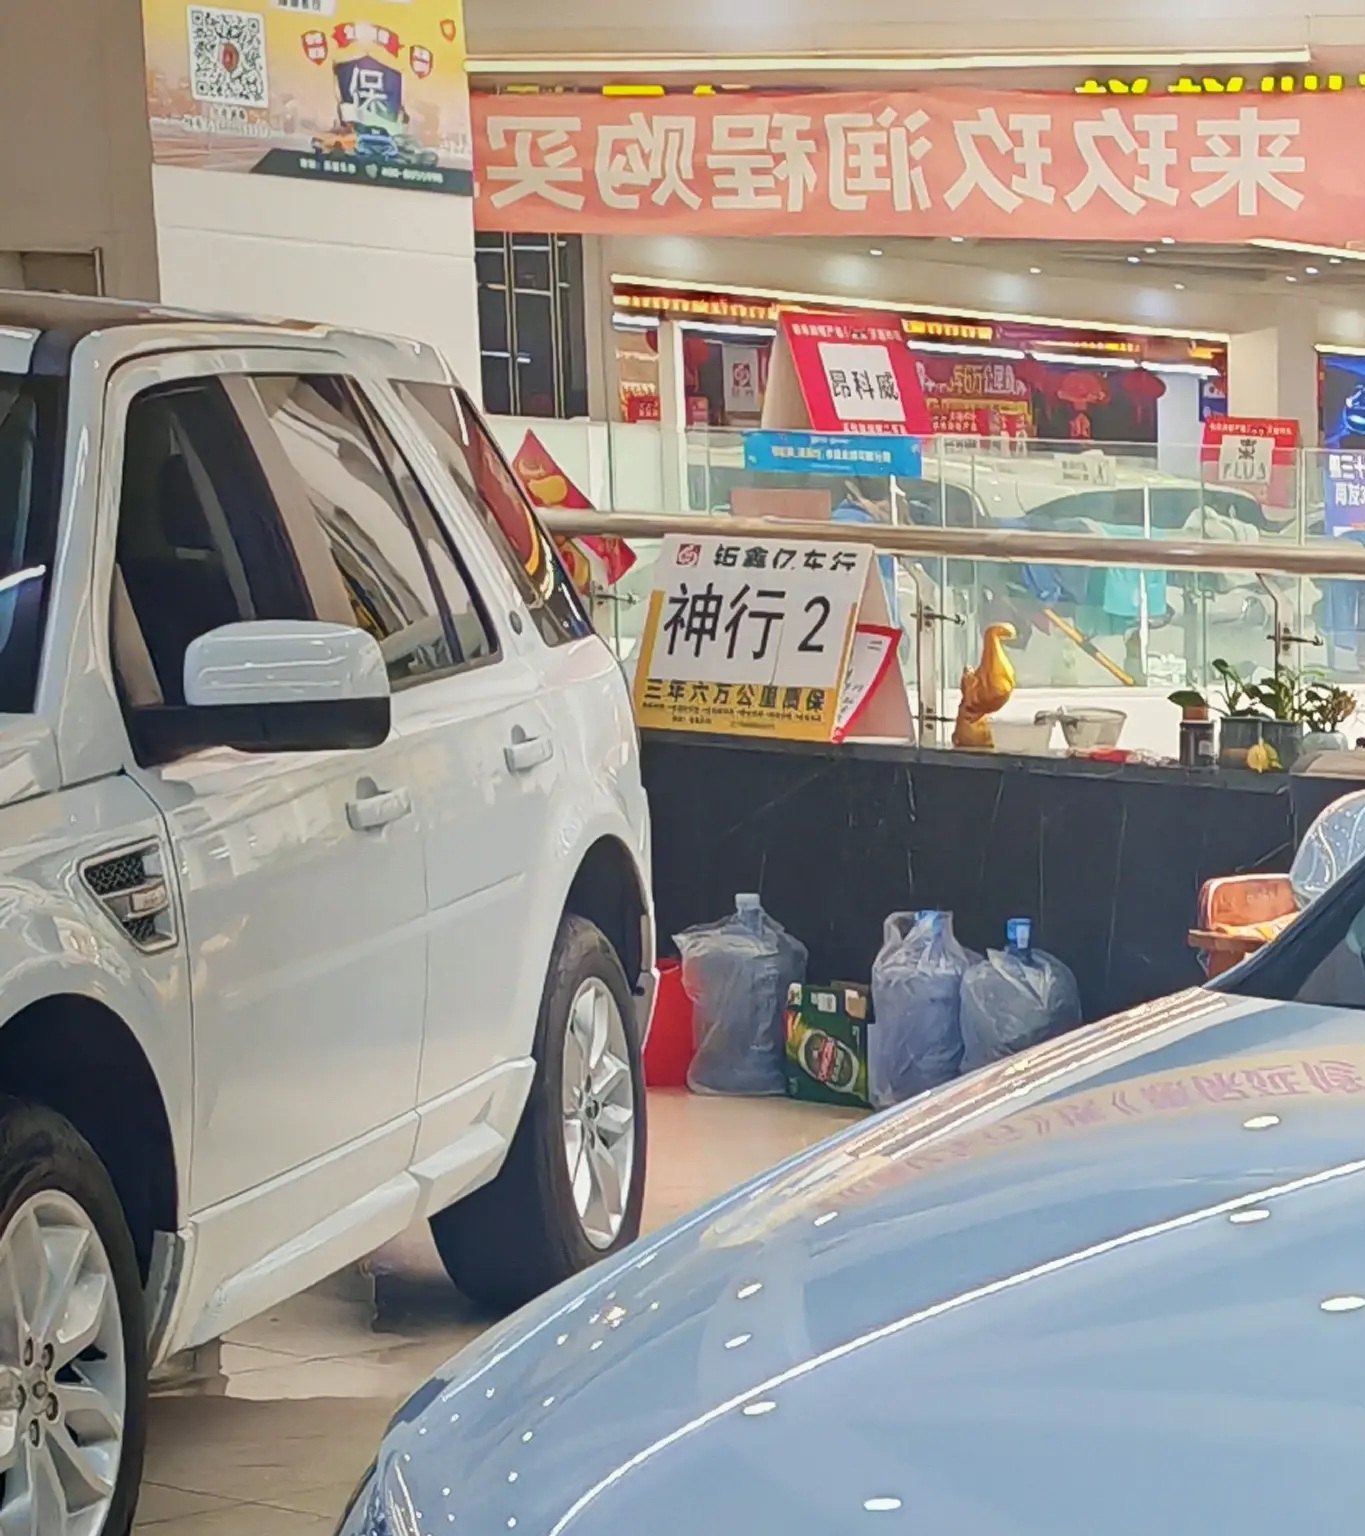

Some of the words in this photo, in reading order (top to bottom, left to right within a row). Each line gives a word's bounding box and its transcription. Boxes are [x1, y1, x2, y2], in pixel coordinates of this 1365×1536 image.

[350, 68, 388, 113] 保
[828, 369, 900, 401] 昂科威
[713, 543, 858, 572] 钜鑫亿车行
